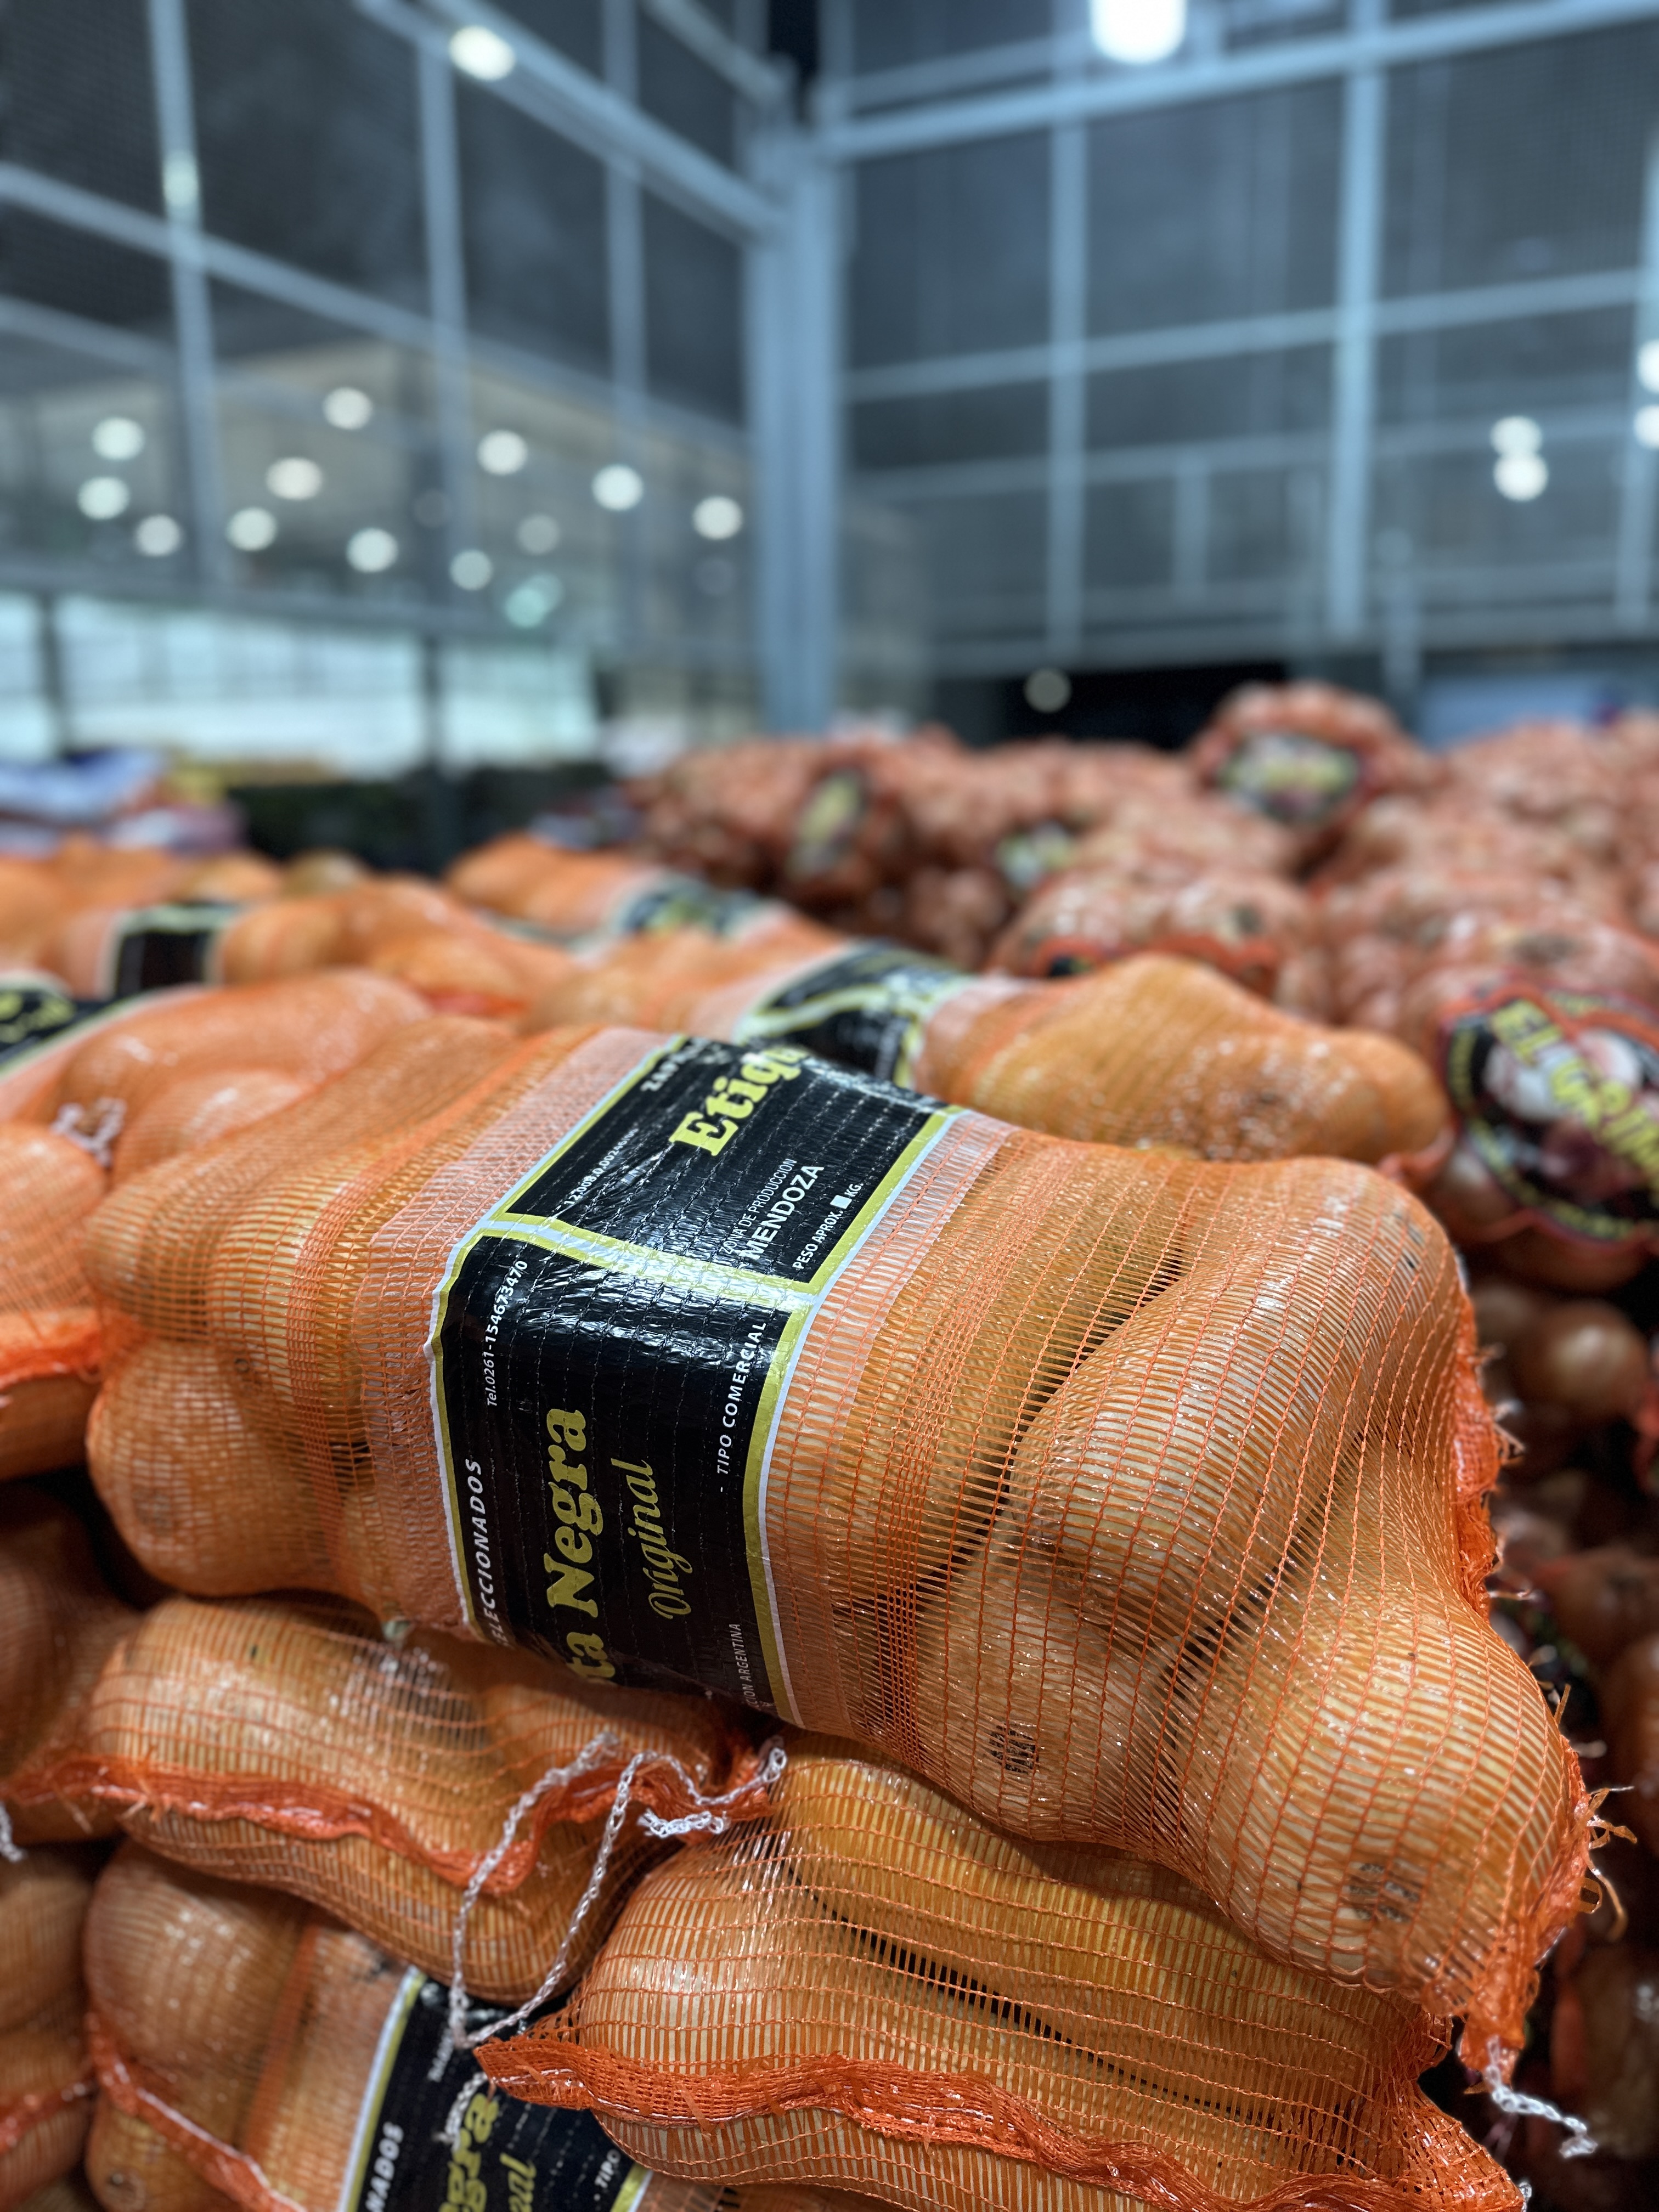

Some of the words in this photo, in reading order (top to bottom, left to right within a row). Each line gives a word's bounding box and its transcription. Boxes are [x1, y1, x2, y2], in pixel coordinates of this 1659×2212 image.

[719, 1226, 747, 1255] ZONA
[738, 1213, 757, 1227] DE
[748, 1158, 797, 1213] PRODUCCION
[738, 1166, 825, 1260] MENDOZA
[792, 1243, 818, 1269] PESO
[811, 1211, 844, 1243] APROX.
[844, 1183, 864, 1197] KG.
[483, 1261, 528, 1406] Tel.0261-154673470
[723, 1322, 766, 1427] COMERCIAL
[717, 1434, 732, 1474] TIPO
[465, 1459, 513, 1647] ELECCIONADOS
[544, 1408, 603, 1617] Negra
[611, 1458, 693, 1619] Original
[729, 1624, 752, 1681] ARGENTINA
[595, 2149, 620, 2188] TIPO
